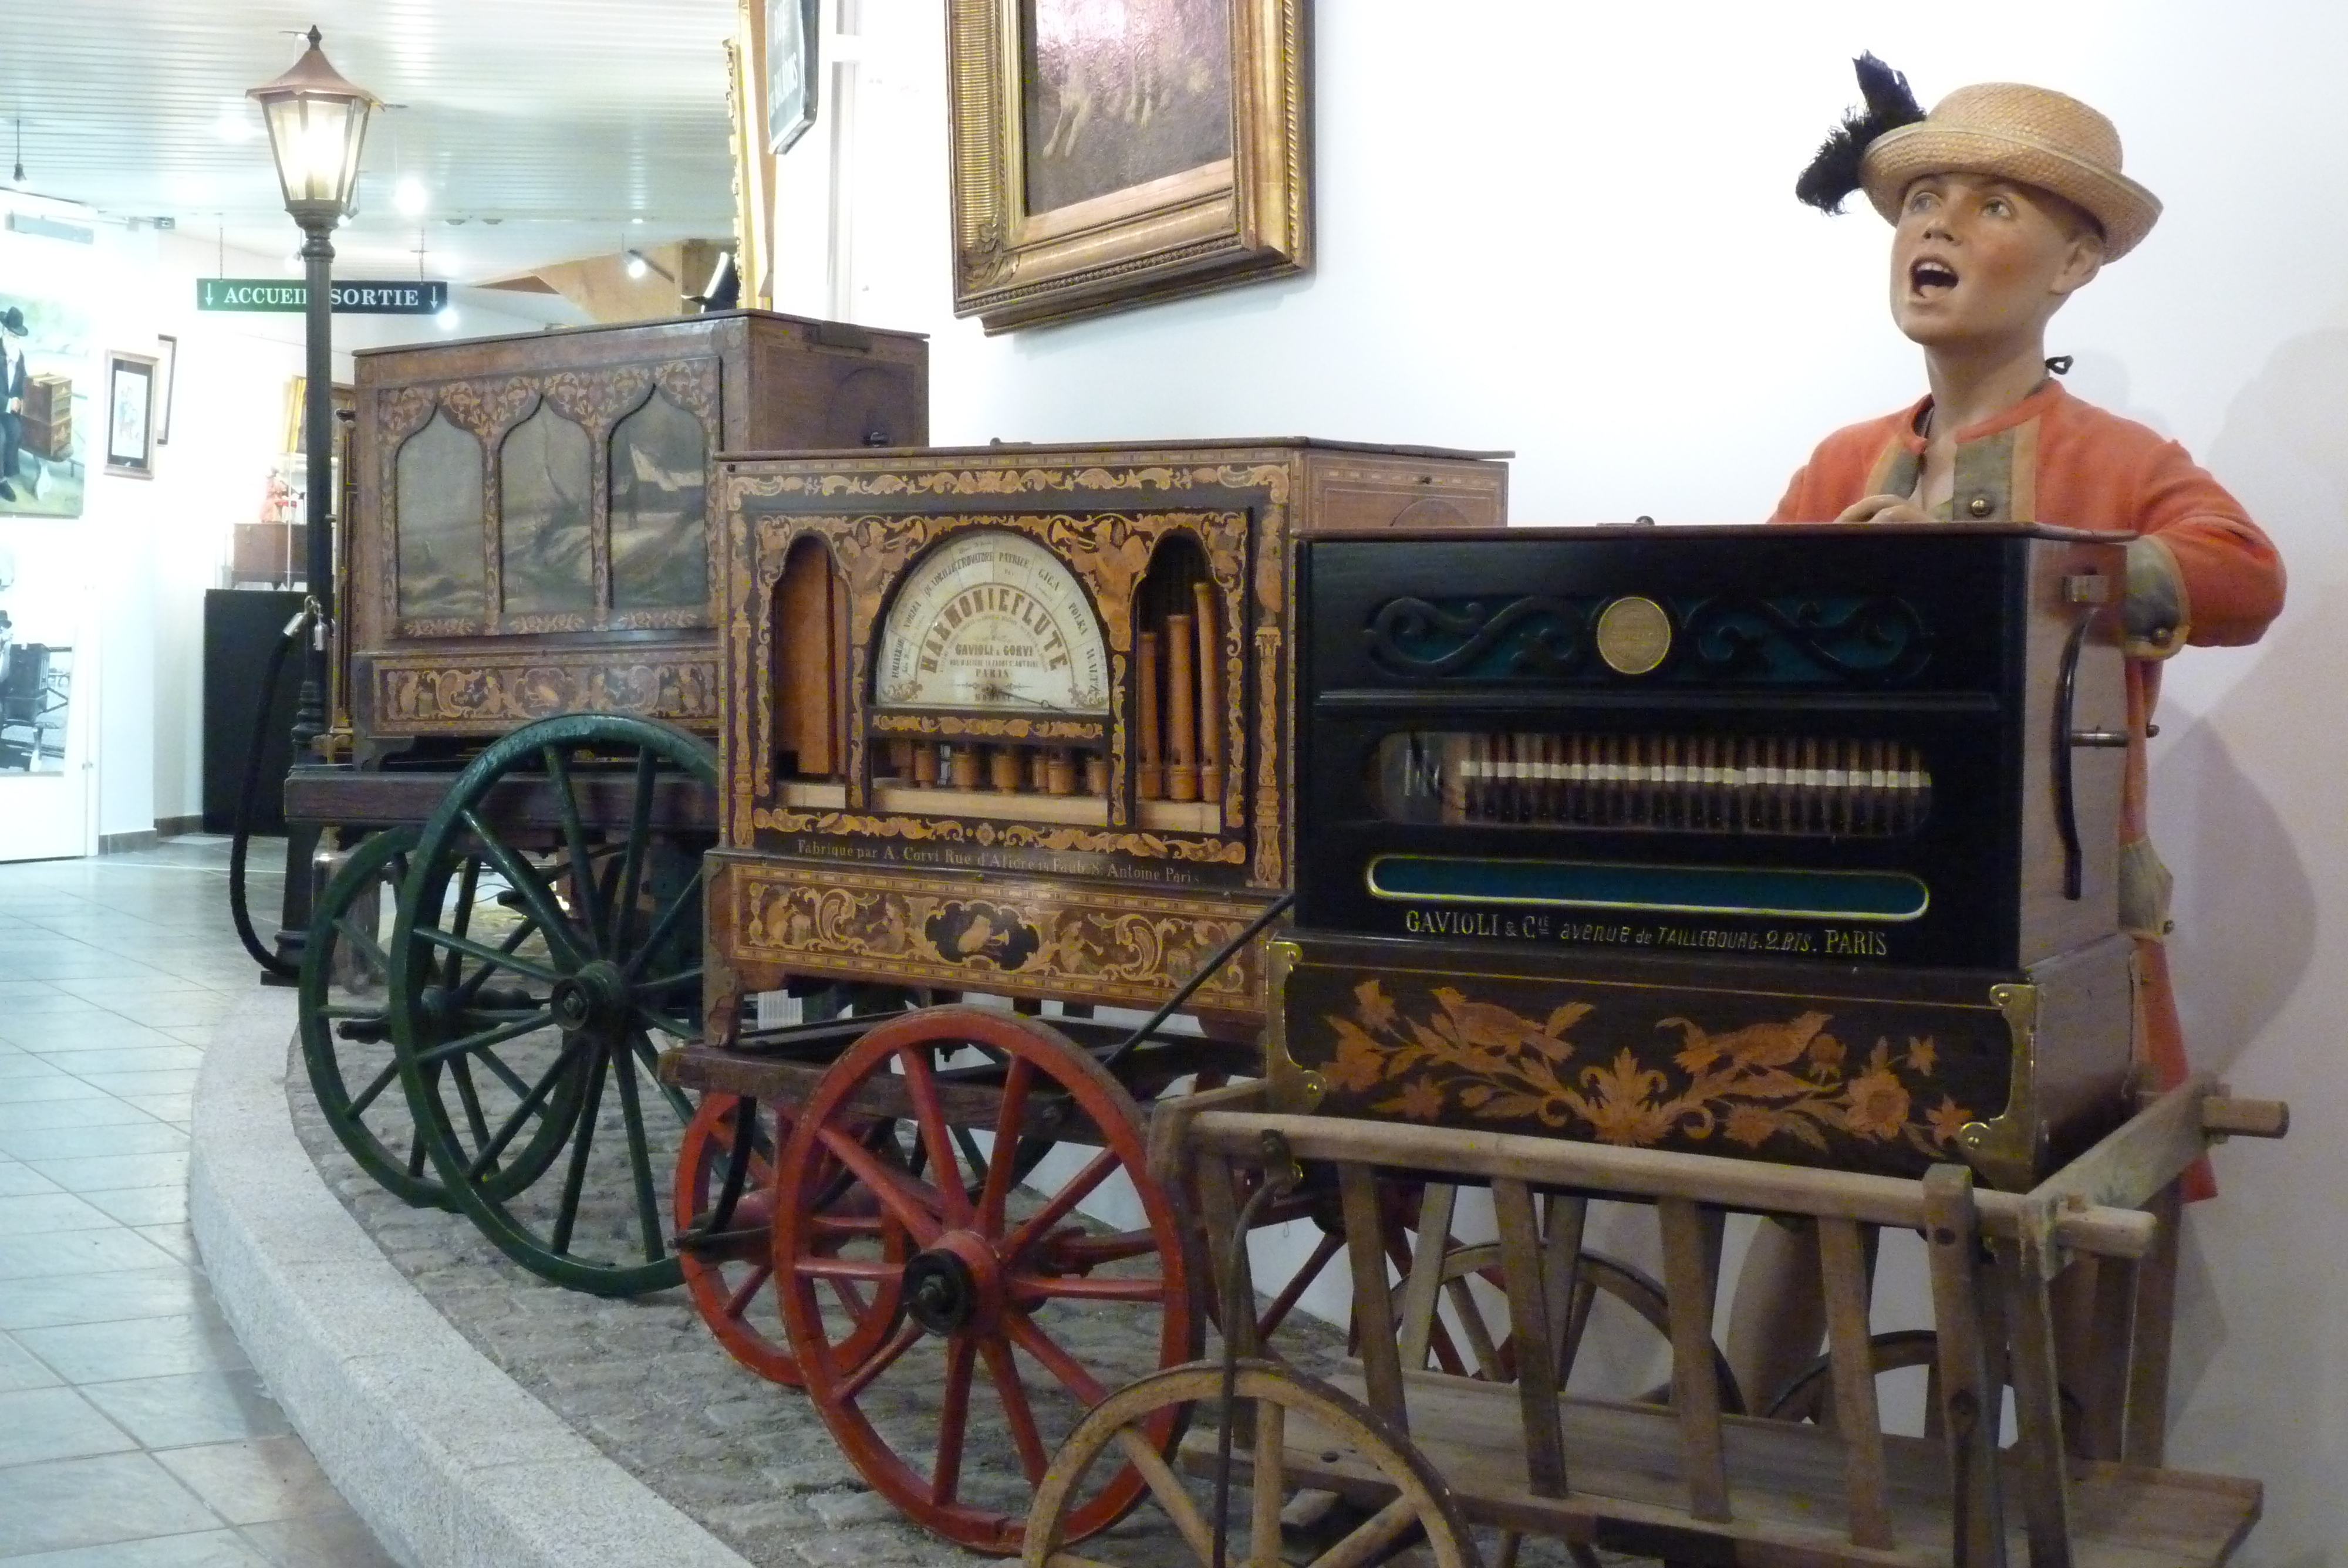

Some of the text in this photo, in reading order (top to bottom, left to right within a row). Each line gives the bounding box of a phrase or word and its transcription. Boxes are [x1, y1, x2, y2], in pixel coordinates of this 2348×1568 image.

[330, 288, 419, 306] SORTIE
[1068, 601, 1088, 636] POLKA
[955, 643, 993, 655] GAVIOLI
[856, 847, 878, 860] par
[903, 847, 939, 863] Corvi
[944, 849, 971, 865] Rue
[1106, 862, 1162, 881] Antoine
[1405, 910, 1499, 936] GAVIOLI
[1504, 921, 1519, 937] &
[1559, 923, 1632, 942] avenue
[1635, 927, 1653, 944] de
[1824, 929, 1888, 956] PARIS
